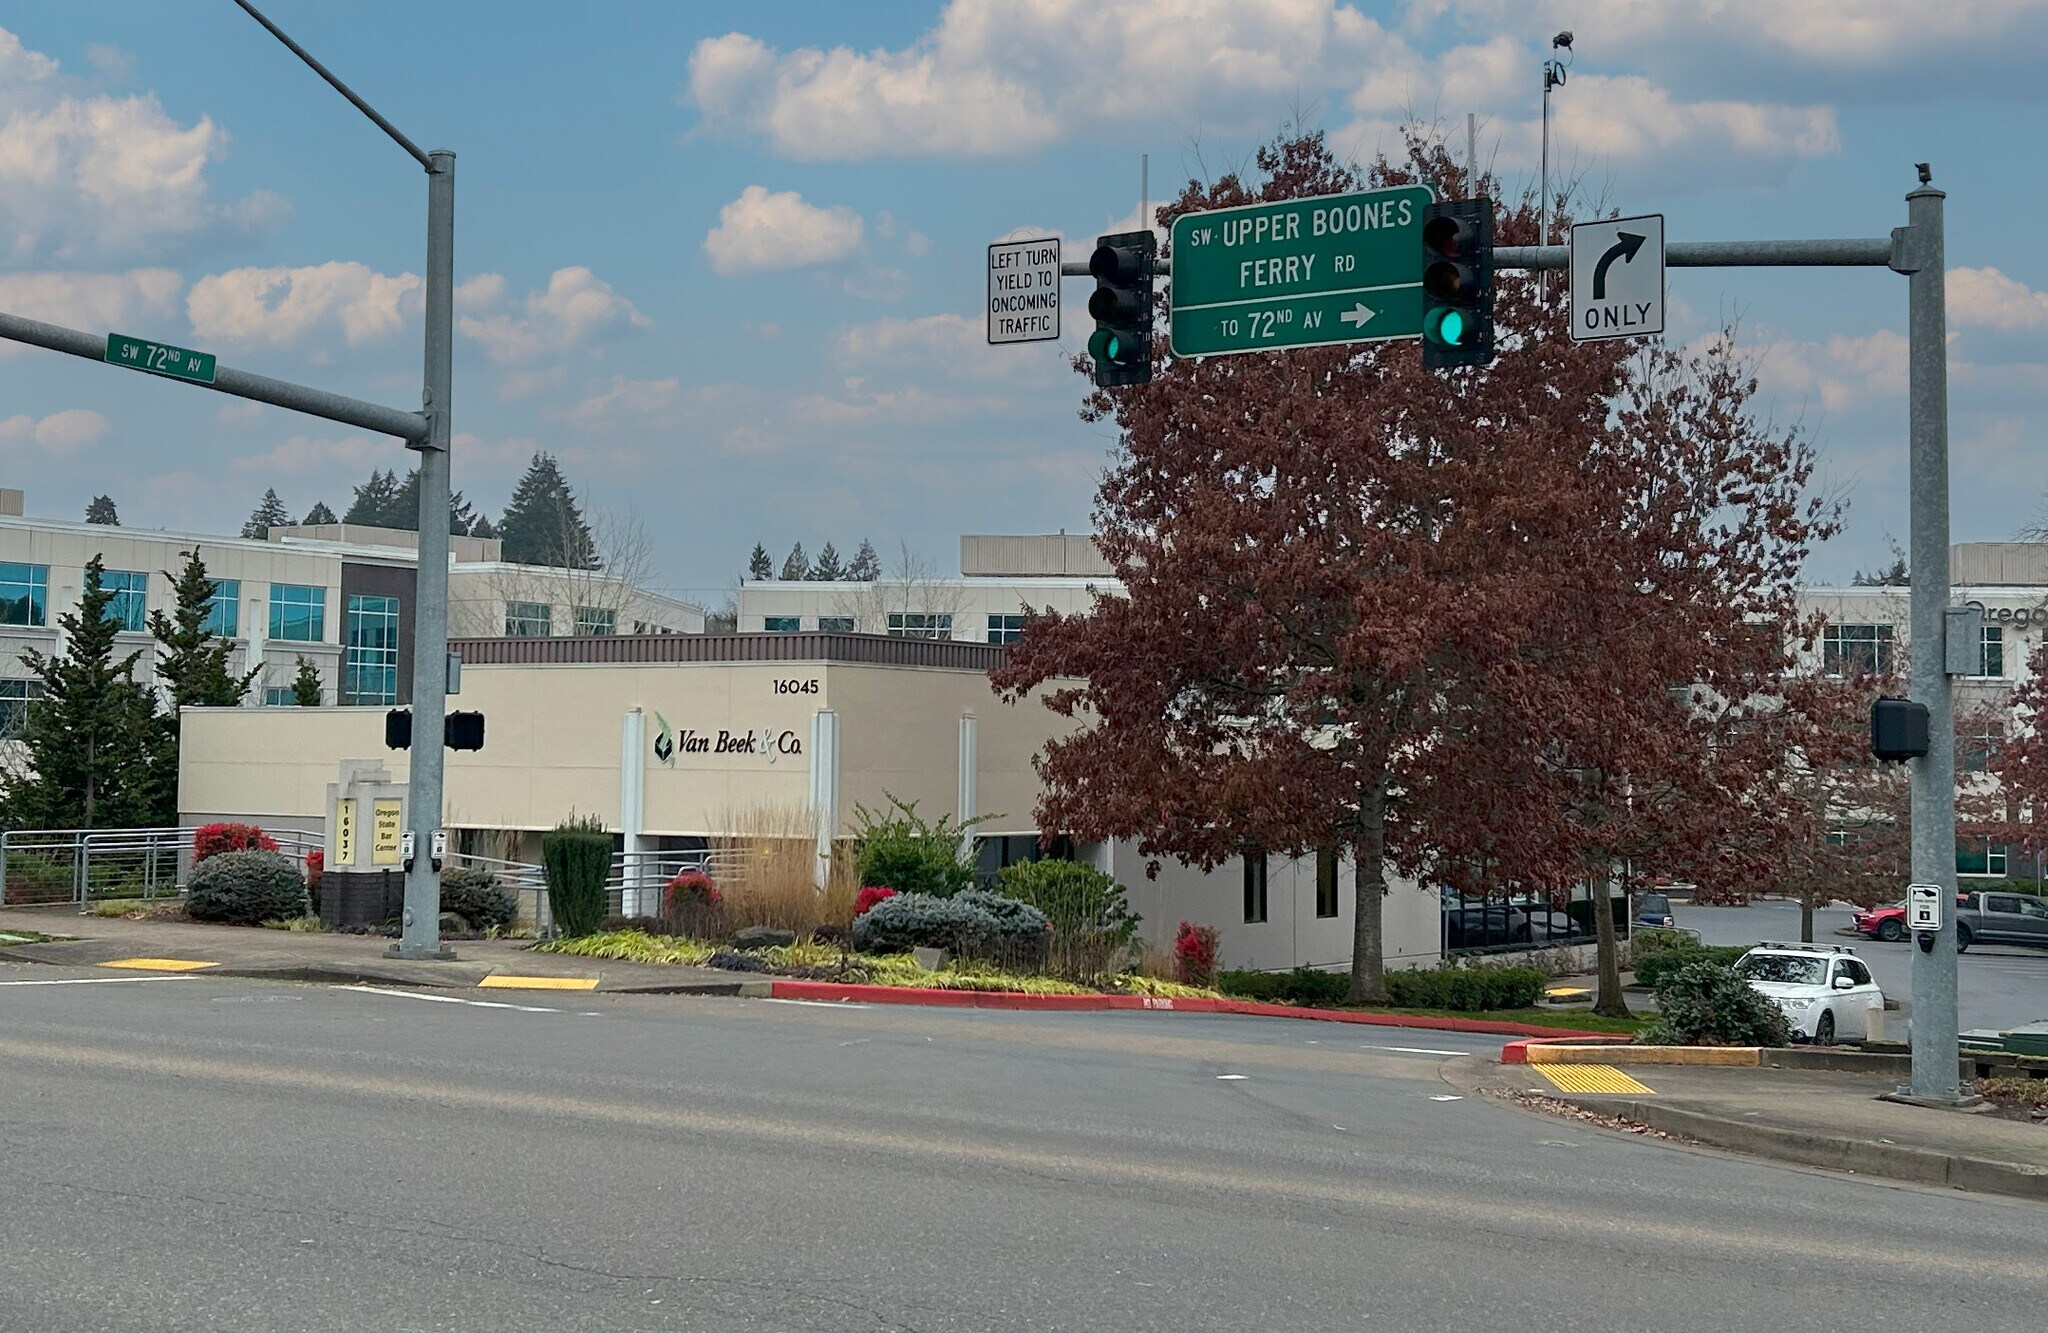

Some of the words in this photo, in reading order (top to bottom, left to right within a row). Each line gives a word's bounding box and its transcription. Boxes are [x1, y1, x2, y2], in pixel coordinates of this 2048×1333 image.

[1191, 228, 1211, 247] SW
[1223, 212, 1300, 247] UPPER
[1312, 199, 1412, 237] BOONES
[991, 251, 1021, 269] LEFT
[1026, 248, 1057, 266] TURN
[996, 273, 1032, 290] YIELD
[1037, 270, 1052, 287] TO
[1240, 253, 1316, 288] FERRY
[1334, 255, 1355, 273] RD
[991, 292, 1057, 313] ONCOMING
[998, 315, 1050, 334] TRAFFIC
[1221, 319, 1238, 337] TO
[1247, 309, 1293, 339] 72ND
[1303, 310, 1322, 329] AV
[1585, 302, 1652, 329] ONLY
[121, 343, 139, 360] SW
[146, 345, 181, 370] 72ND
[187, 357, 202, 373] AV
[773, 679, 819, 694] 16045
[678, 729, 709, 752] Van
[713, 729, 757, 753] Beek
[375, 808, 399, 817] Oregon
[381, 832, 393, 840] Bar
